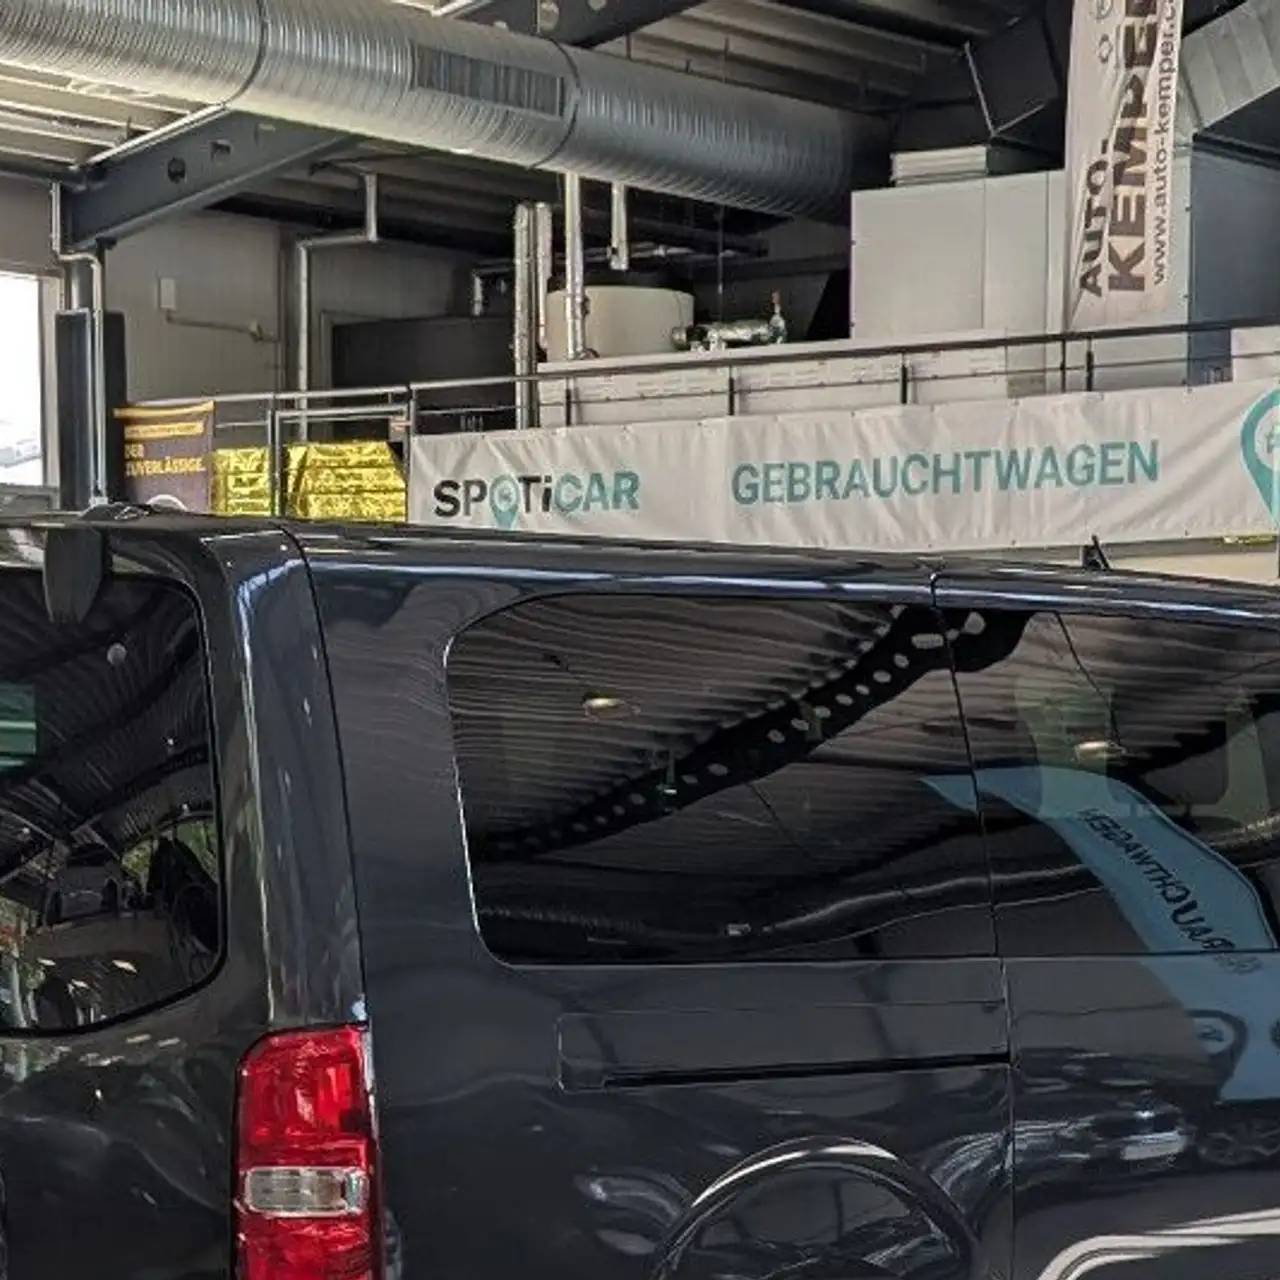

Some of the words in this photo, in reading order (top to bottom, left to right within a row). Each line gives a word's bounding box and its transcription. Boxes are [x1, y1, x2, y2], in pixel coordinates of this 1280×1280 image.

[1079, 139, 1109, 297] AUTO-
[1150, 0, 1177, 285] www.auto-kemper.c
[730, 439, 1161, 506] GEBRAUCHTWAGEN
